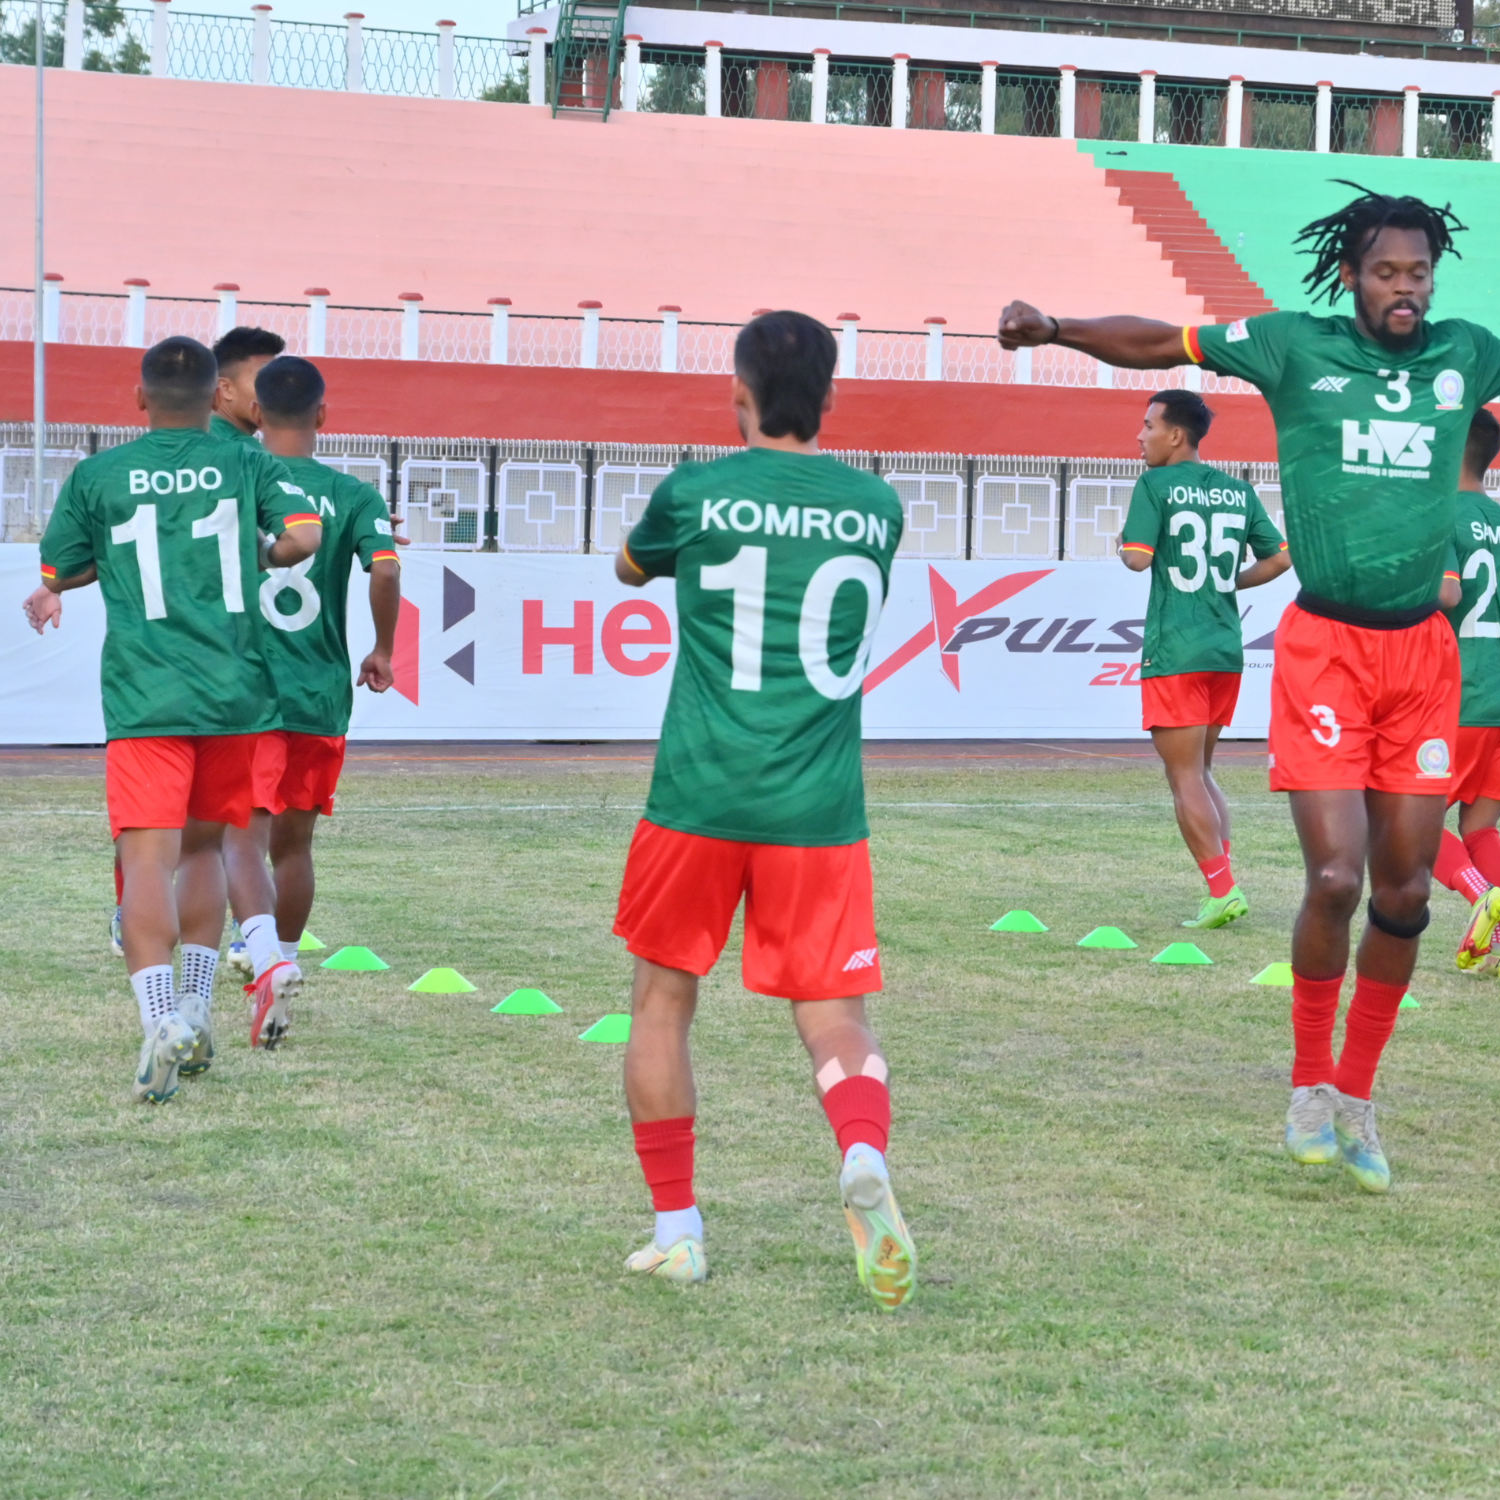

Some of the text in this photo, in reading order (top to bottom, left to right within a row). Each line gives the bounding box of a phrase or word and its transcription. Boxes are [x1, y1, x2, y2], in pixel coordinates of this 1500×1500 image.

[1374, 368, 1412, 413] 3
[1342, 419, 1436, 468] HVS
[129, 466, 223, 496] BODO
[1342, 462, 1380, 476] Inspiring
[1388, 468, 1430, 479] generation
[1167, 486, 1246, 508] JOHNSON
[701, 498, 888, 550] KOMRON
[110, 498, 245, 621] 11
[1167, 510, 1246, 593] 35
[522, 599, 672, 677] He
[700, 544, 885, 701] 10
[862, 563, 1145, 693] XPULS
[1310, 704, 1342, 748] 3
